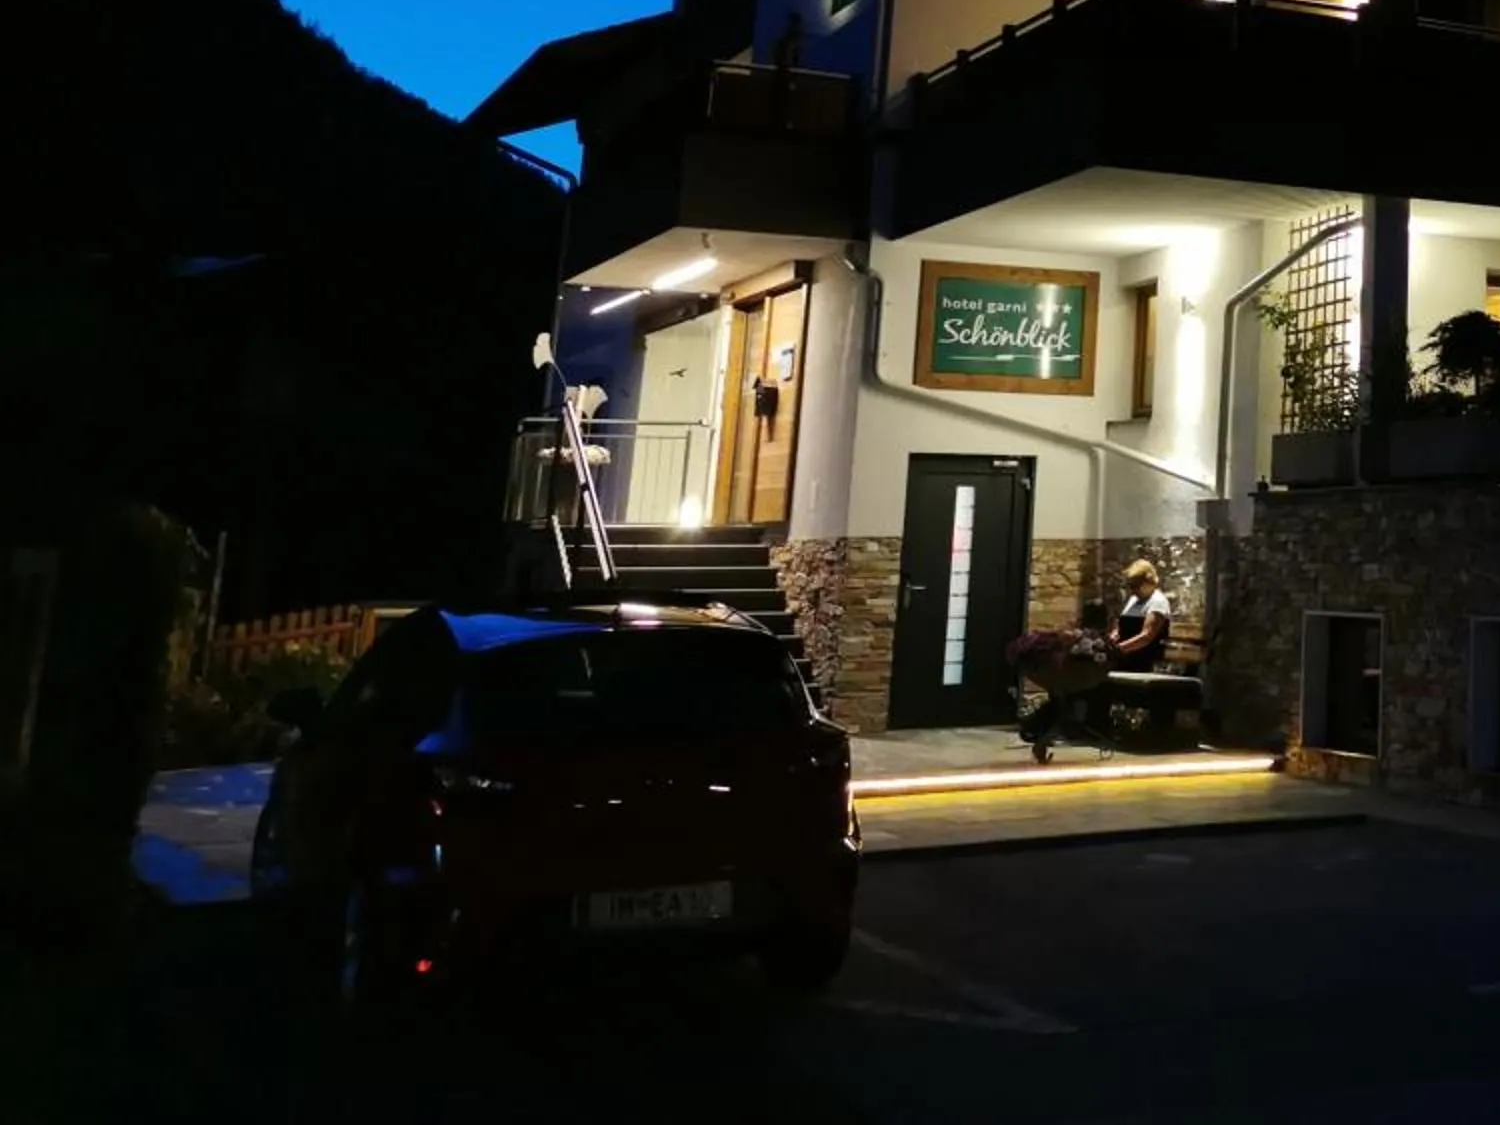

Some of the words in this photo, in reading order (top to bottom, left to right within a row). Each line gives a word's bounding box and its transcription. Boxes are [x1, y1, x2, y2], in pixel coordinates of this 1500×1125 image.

[942, 296, 983, 311] hotel
[987, 300, 1028, 314] garni
[938, 315, 1072, 351] Schönblick
